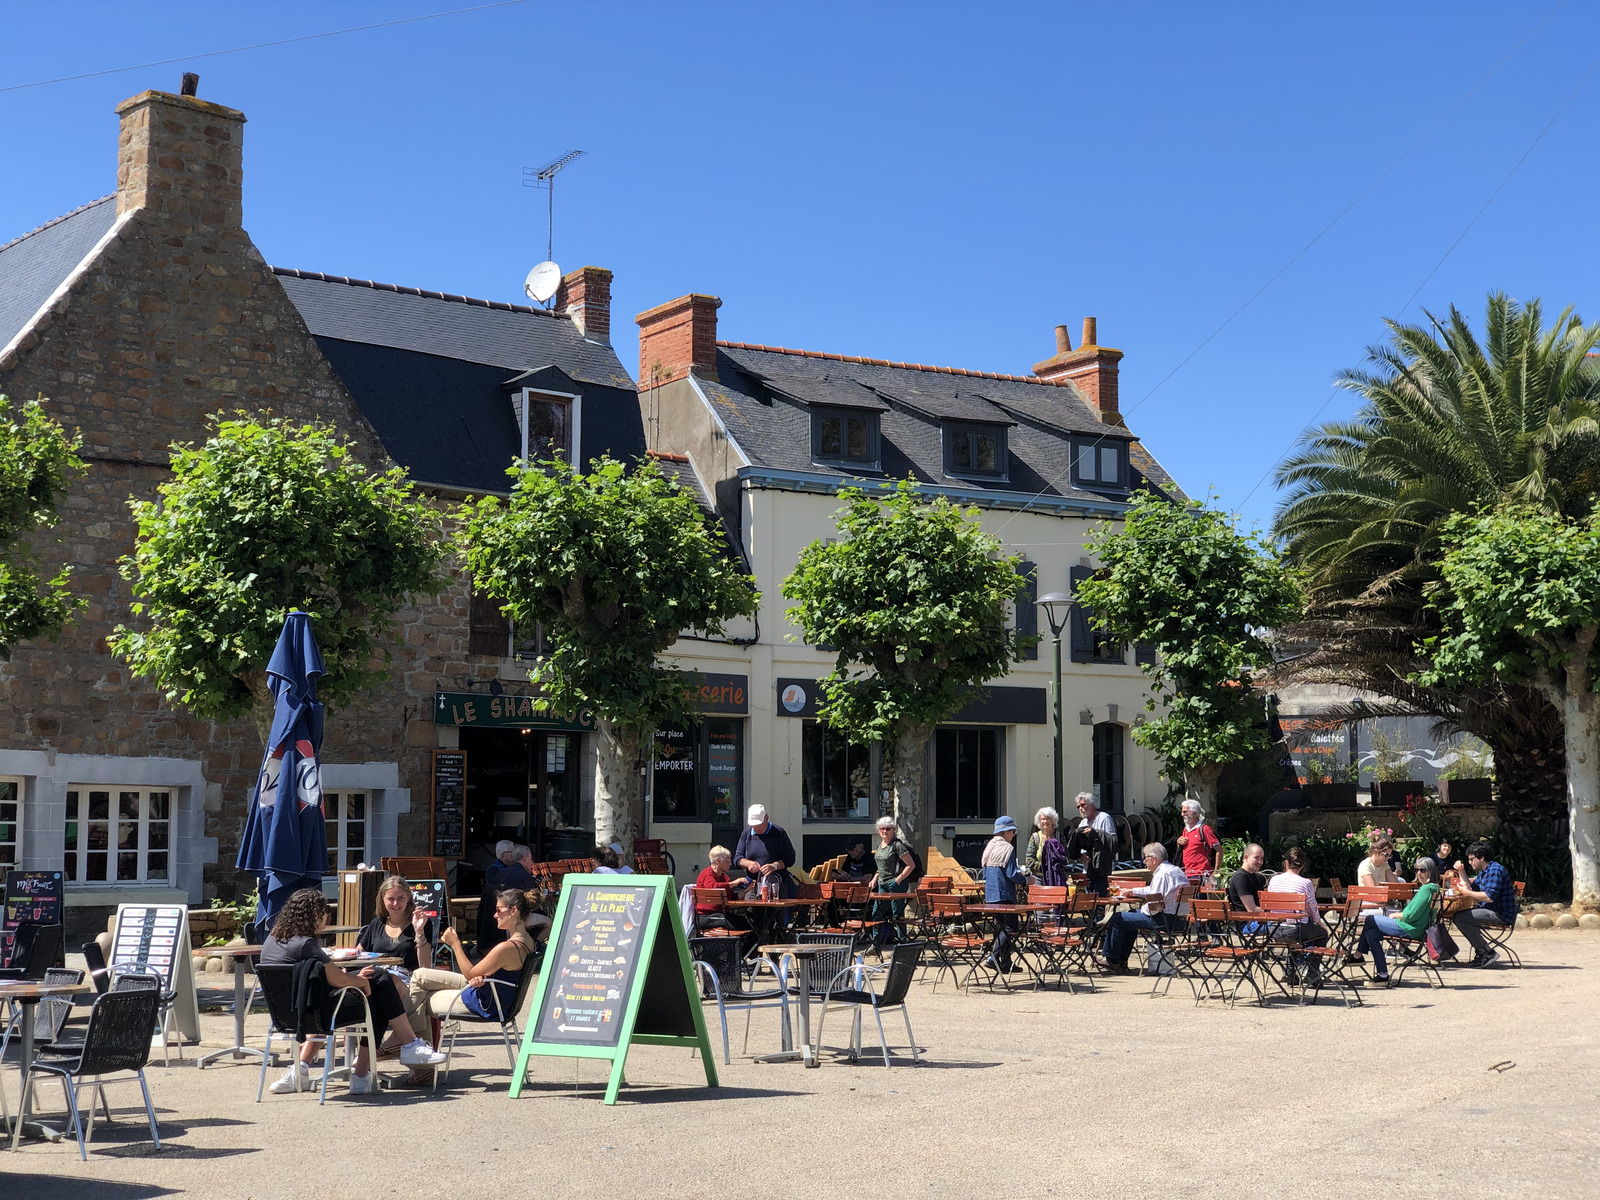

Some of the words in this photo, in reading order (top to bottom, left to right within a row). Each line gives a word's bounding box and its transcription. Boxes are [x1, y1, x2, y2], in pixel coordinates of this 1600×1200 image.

[681, 681, 744, 704] asserie
[452, 701, 478, 725] LE
[655, 729, 667, 738] Sur
[668, 729, 684, 740] place
[655, 760, 694, 771] EMPORTER
[1279, 758, 1303, 768] Crêpes
[587, 891, 594, 901] LA
[596, 891, 635, 902] SANDWICHERIE
[590, 902, 599, 912] DE
[600, 903, 607, 912] LA
